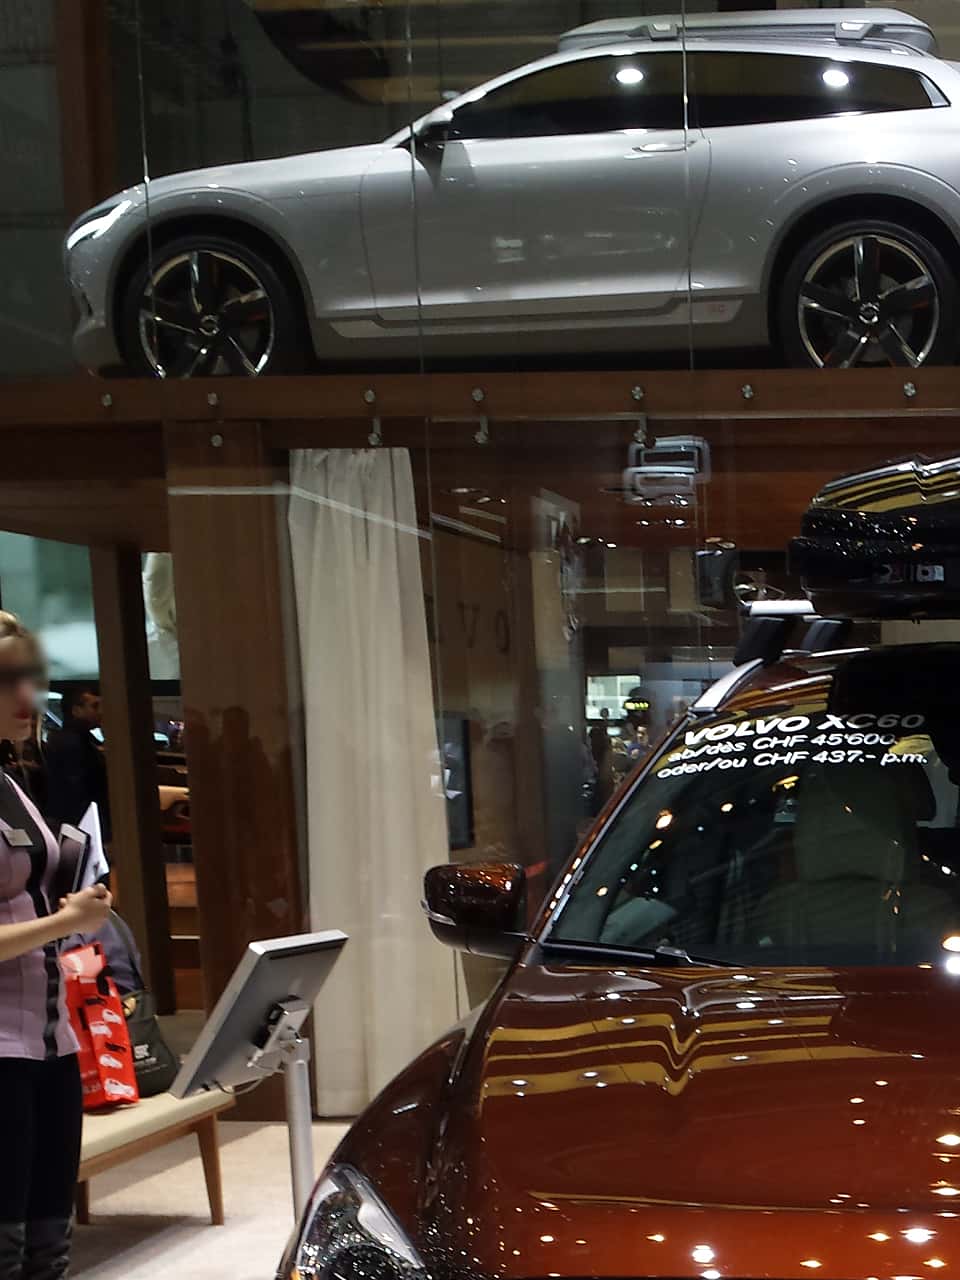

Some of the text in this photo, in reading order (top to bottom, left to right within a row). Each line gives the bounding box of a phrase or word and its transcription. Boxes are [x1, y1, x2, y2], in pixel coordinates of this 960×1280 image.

[684, 713, 925, 746] VOLVO XC60
[752, 734, 809, 751] CHF
[657, 749, 928, 779] oder/ou CHF 437.- p.m.
